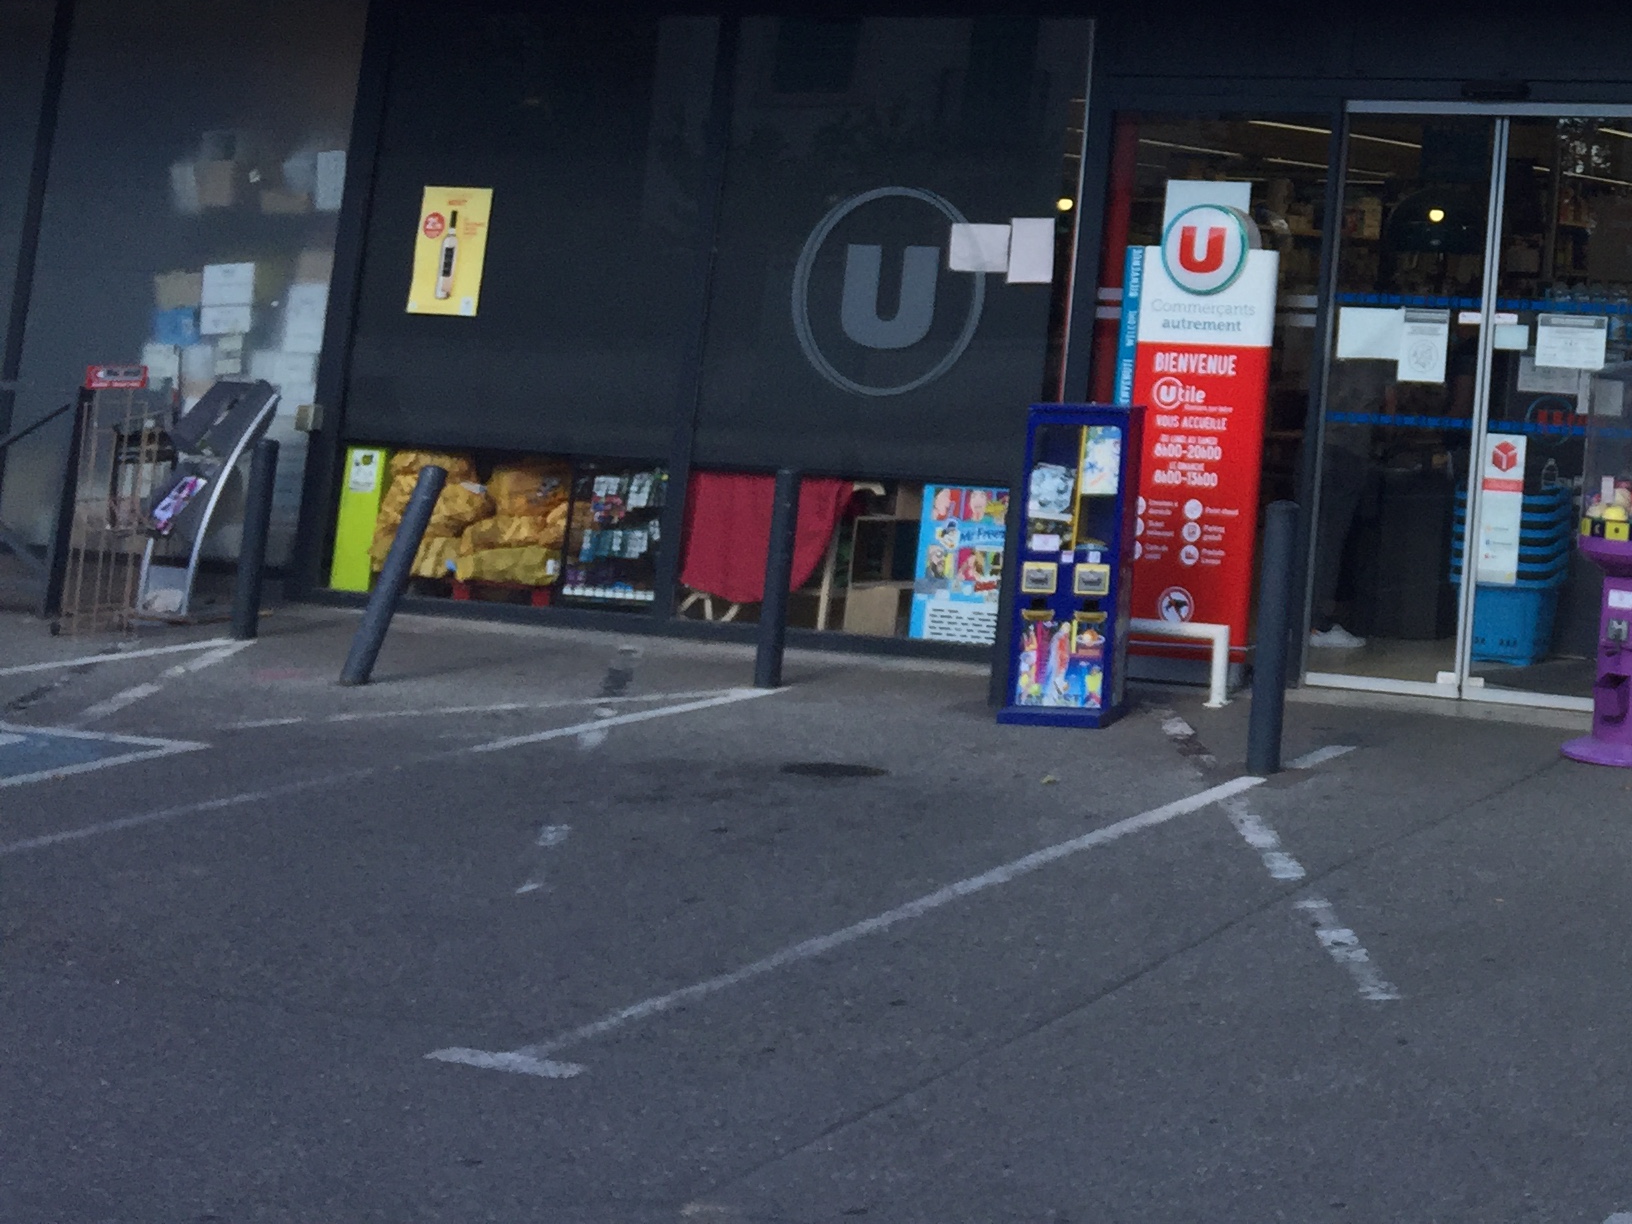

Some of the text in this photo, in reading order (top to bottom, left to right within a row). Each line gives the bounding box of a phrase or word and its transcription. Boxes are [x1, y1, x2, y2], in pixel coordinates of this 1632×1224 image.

[1178, 226, 1227, 273] U
[841, 243, 940, 349] U
[1151, 299, 1256, 317] Commerçants
[1161, 318, 1242, 332] autrement
[1154, 352, 1238, 376] BIENVENUE
